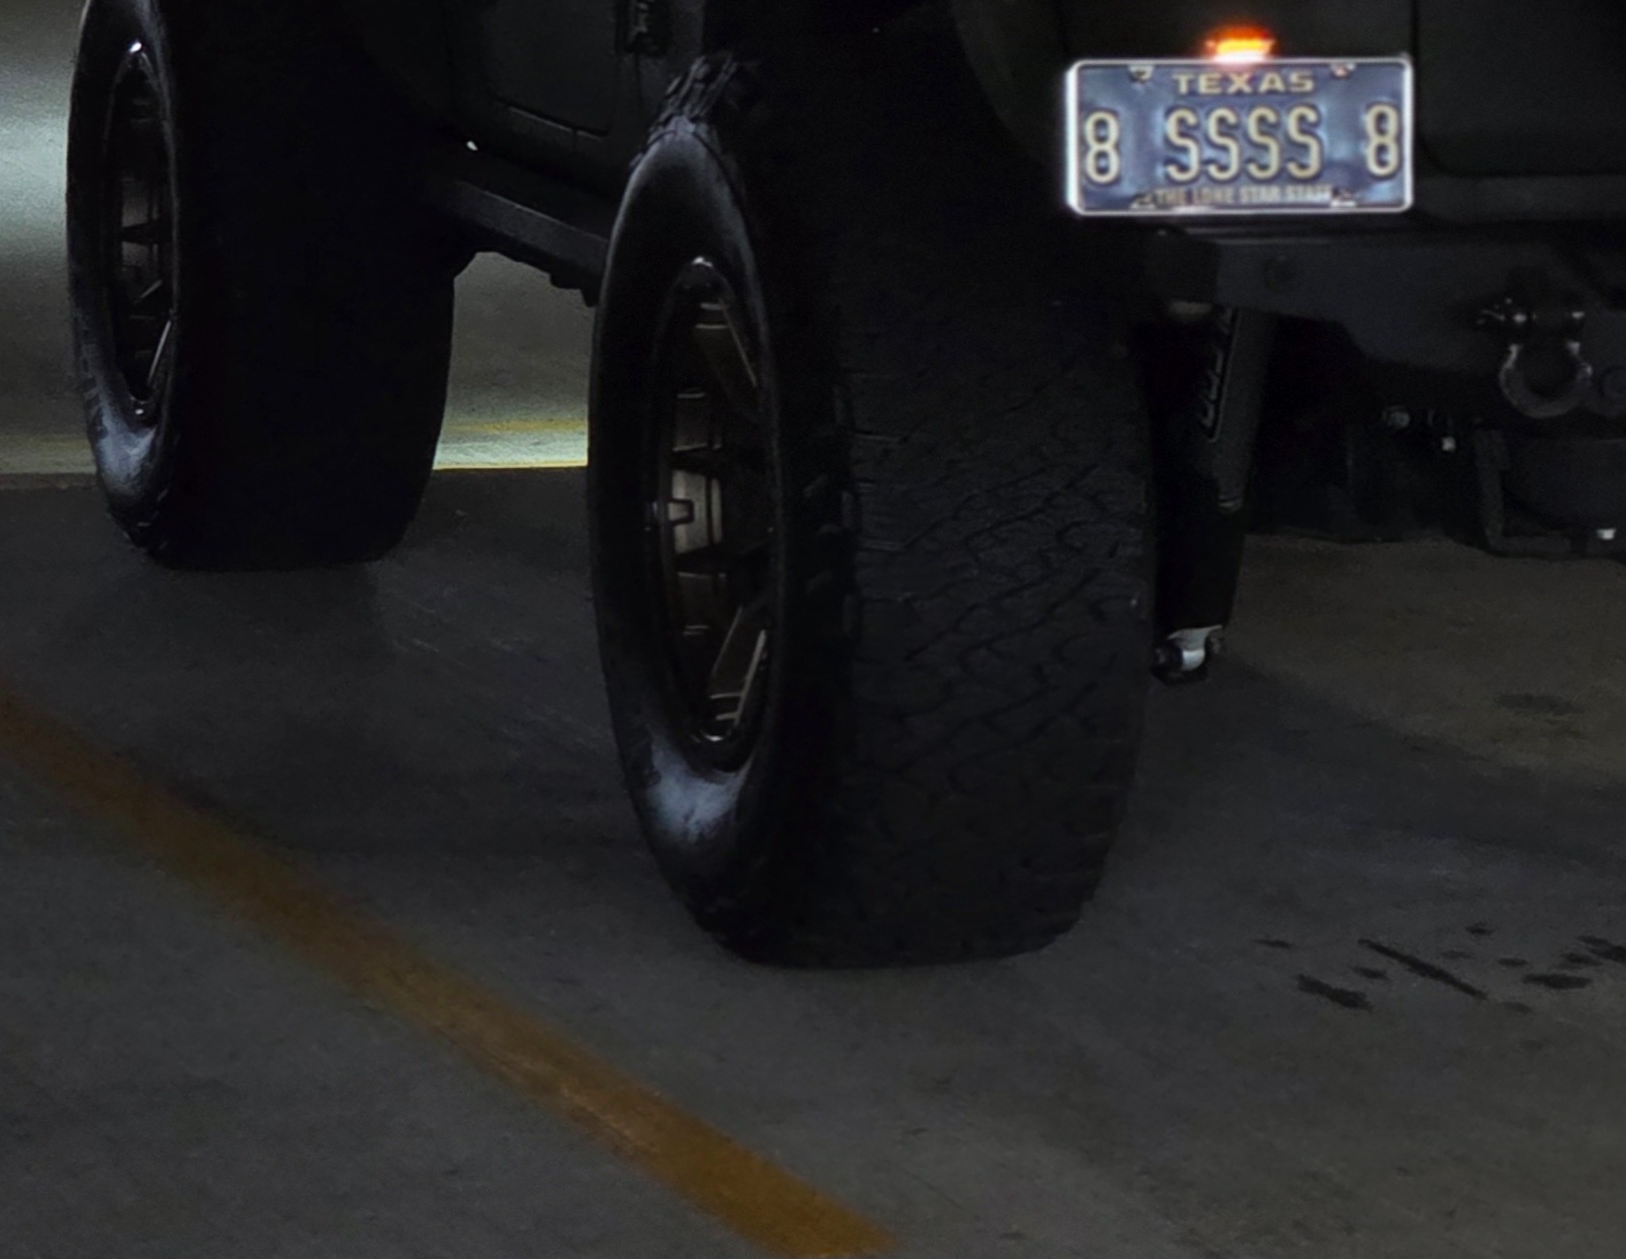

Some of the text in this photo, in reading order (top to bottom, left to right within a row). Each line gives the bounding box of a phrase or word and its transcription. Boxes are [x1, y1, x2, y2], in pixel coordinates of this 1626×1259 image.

[1172, 71, 1316, 95] TEXAS
[1084, 103, 1399, 184] 8 SSSS 8
